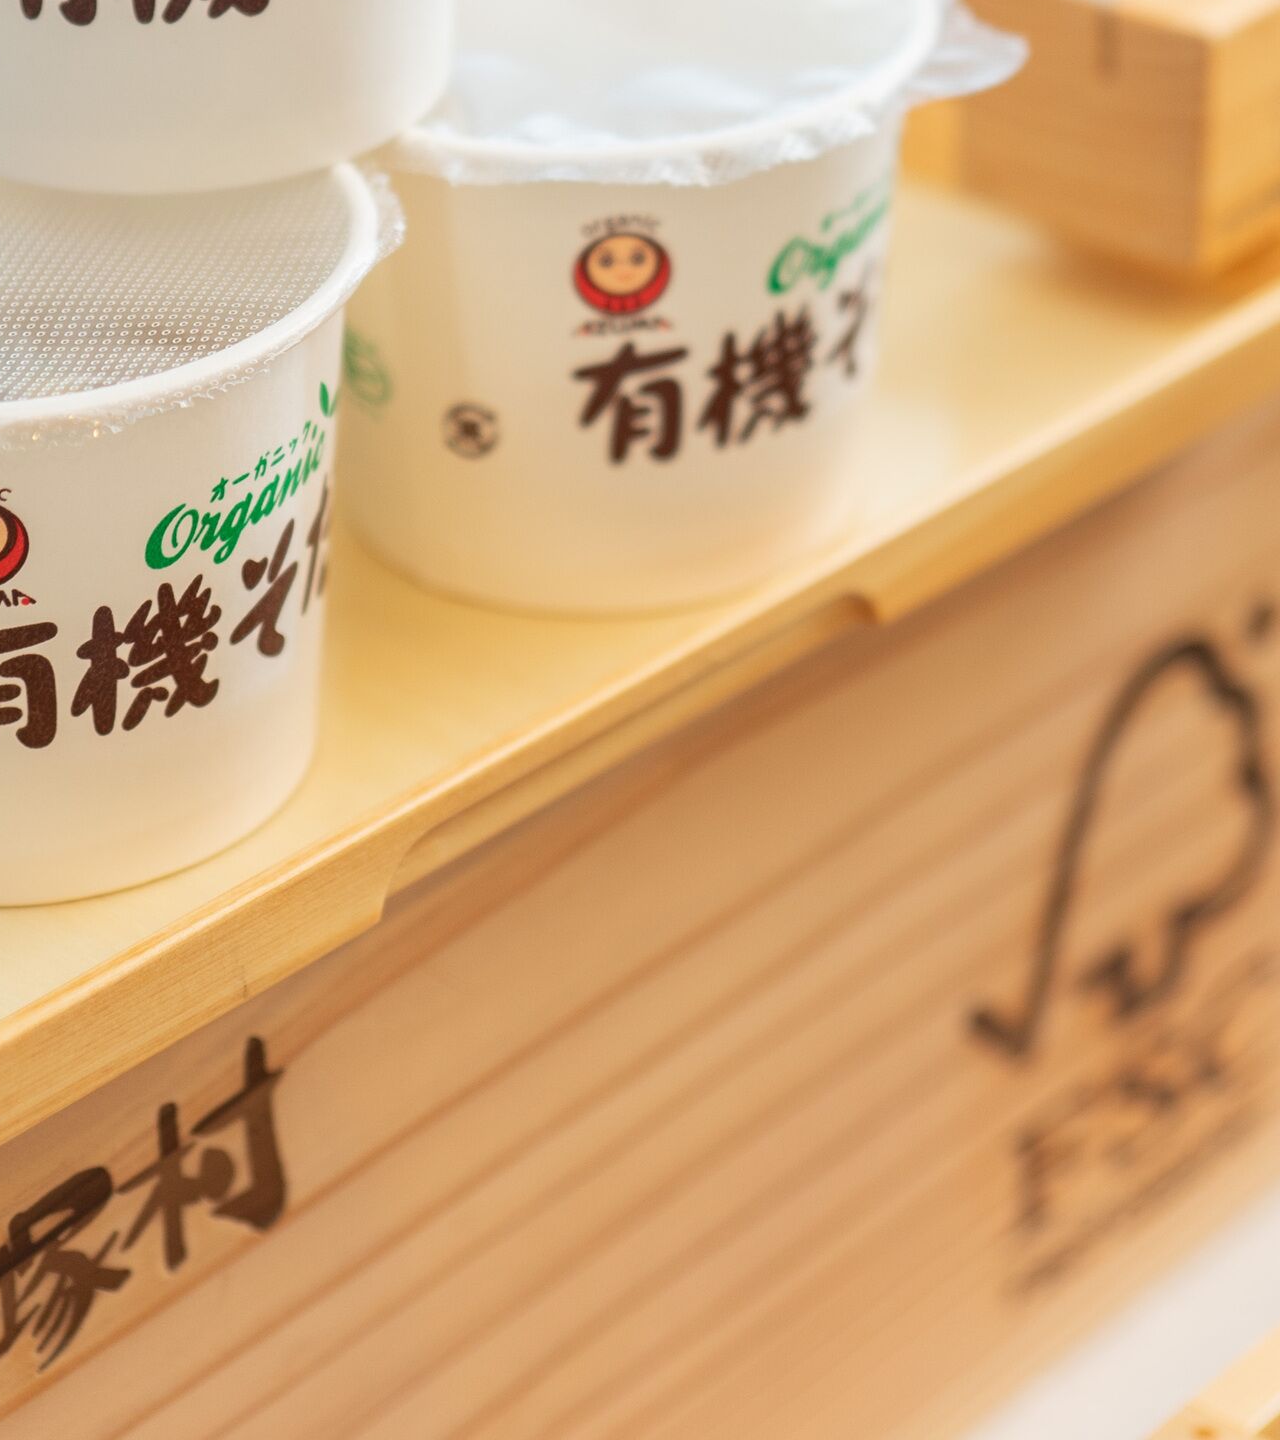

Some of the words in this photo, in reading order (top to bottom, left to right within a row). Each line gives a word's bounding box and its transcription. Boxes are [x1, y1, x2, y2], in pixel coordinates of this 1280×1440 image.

[144, 424, 324, 570] Organic
[209, 420, 310, 503] オーガニック
